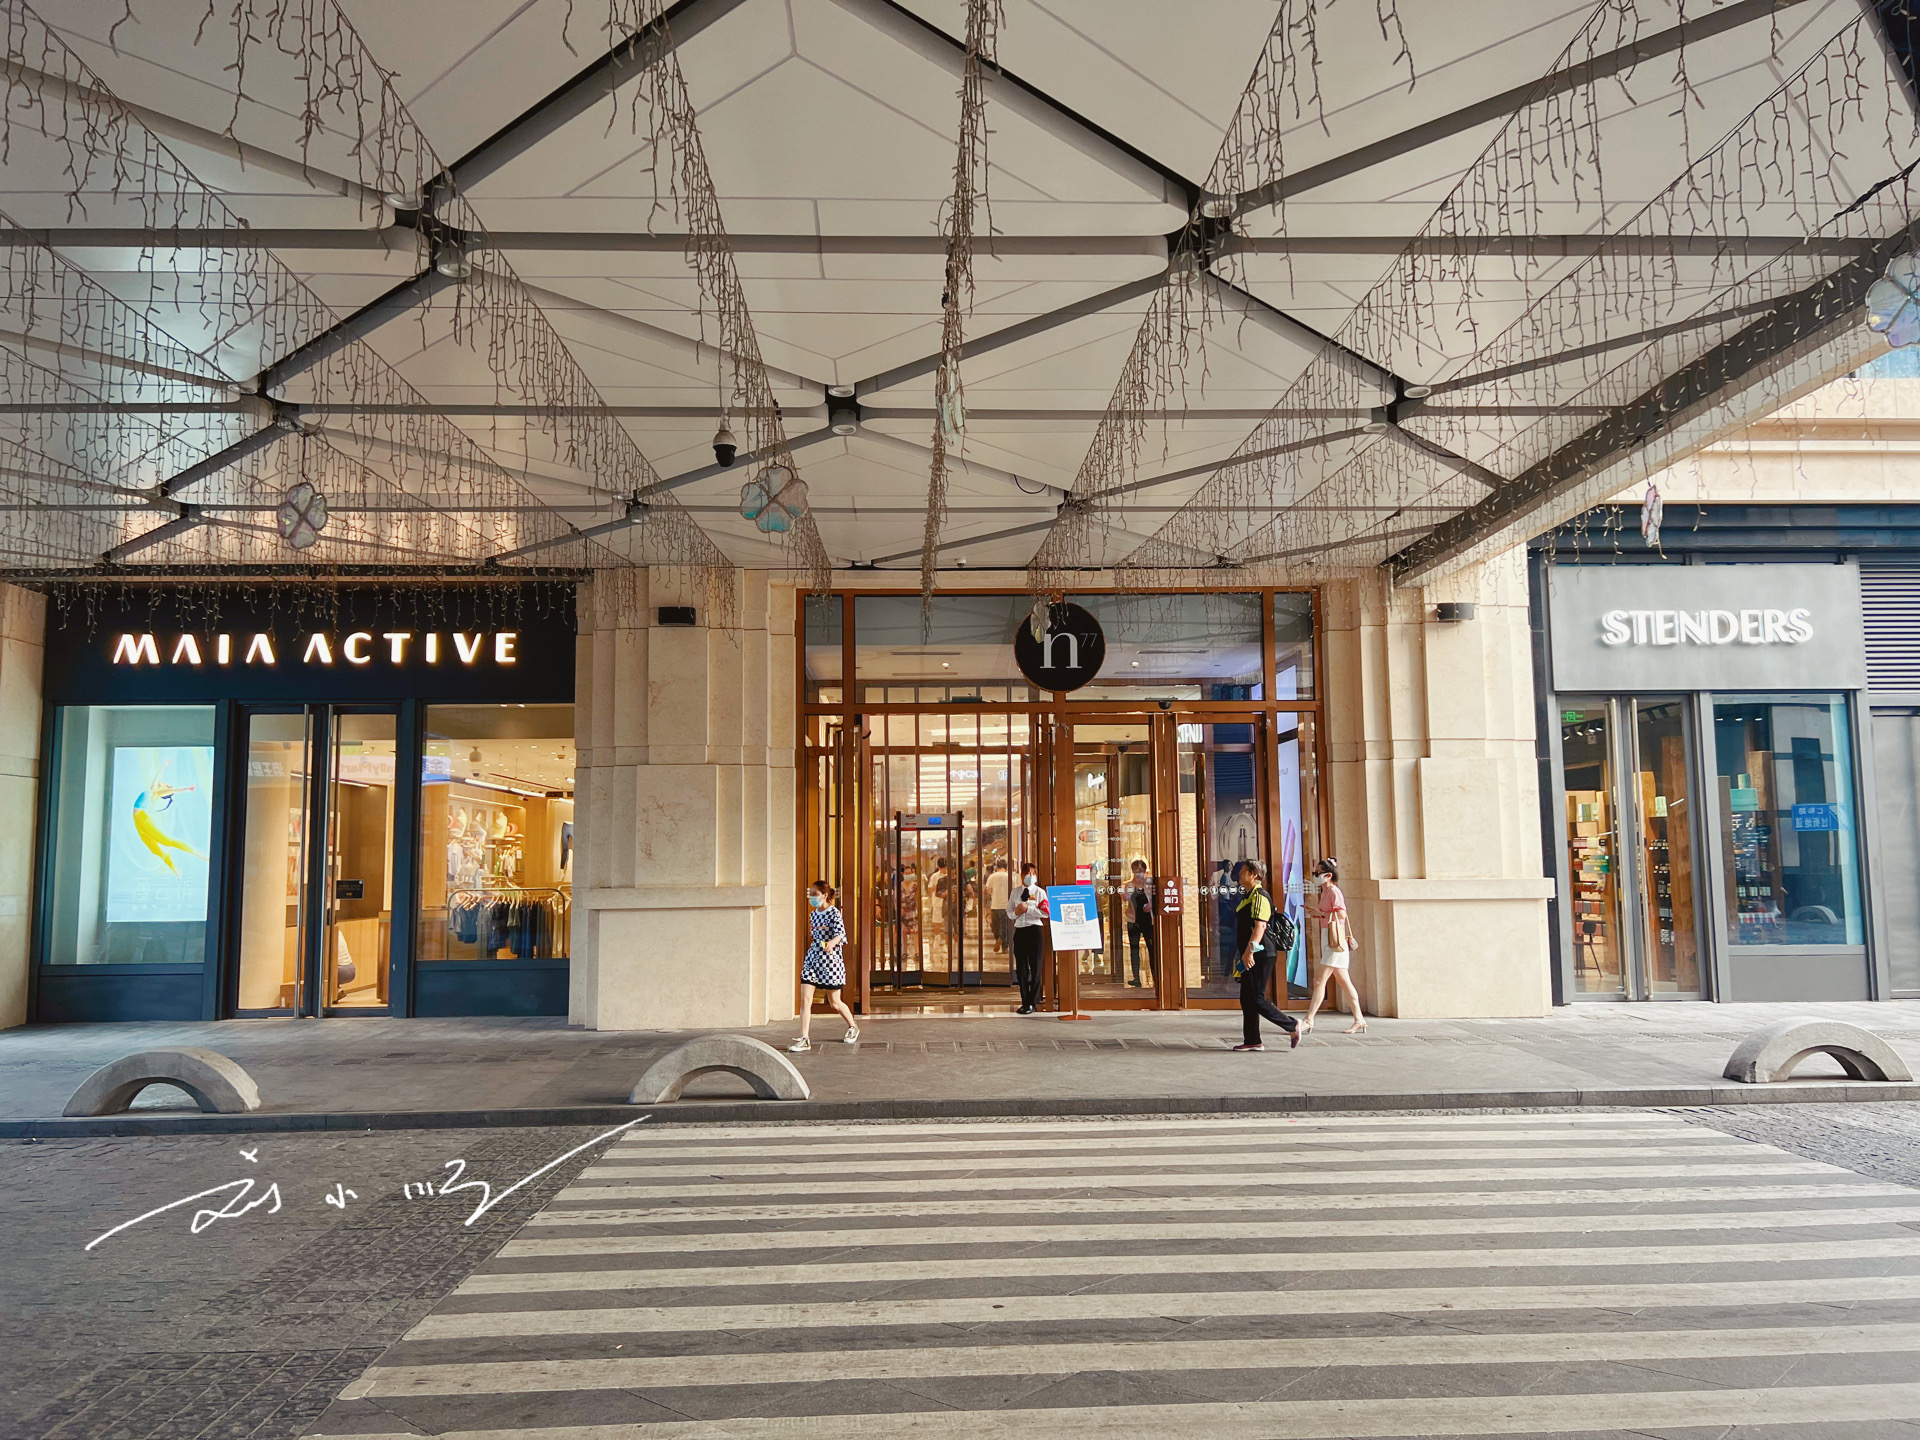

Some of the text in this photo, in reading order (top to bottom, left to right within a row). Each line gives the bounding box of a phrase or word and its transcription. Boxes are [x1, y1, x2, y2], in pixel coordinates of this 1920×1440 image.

[1602, 608, 1813, 645] STENDERS
[113, 632, 517, 664] MAIA ACTIVE
